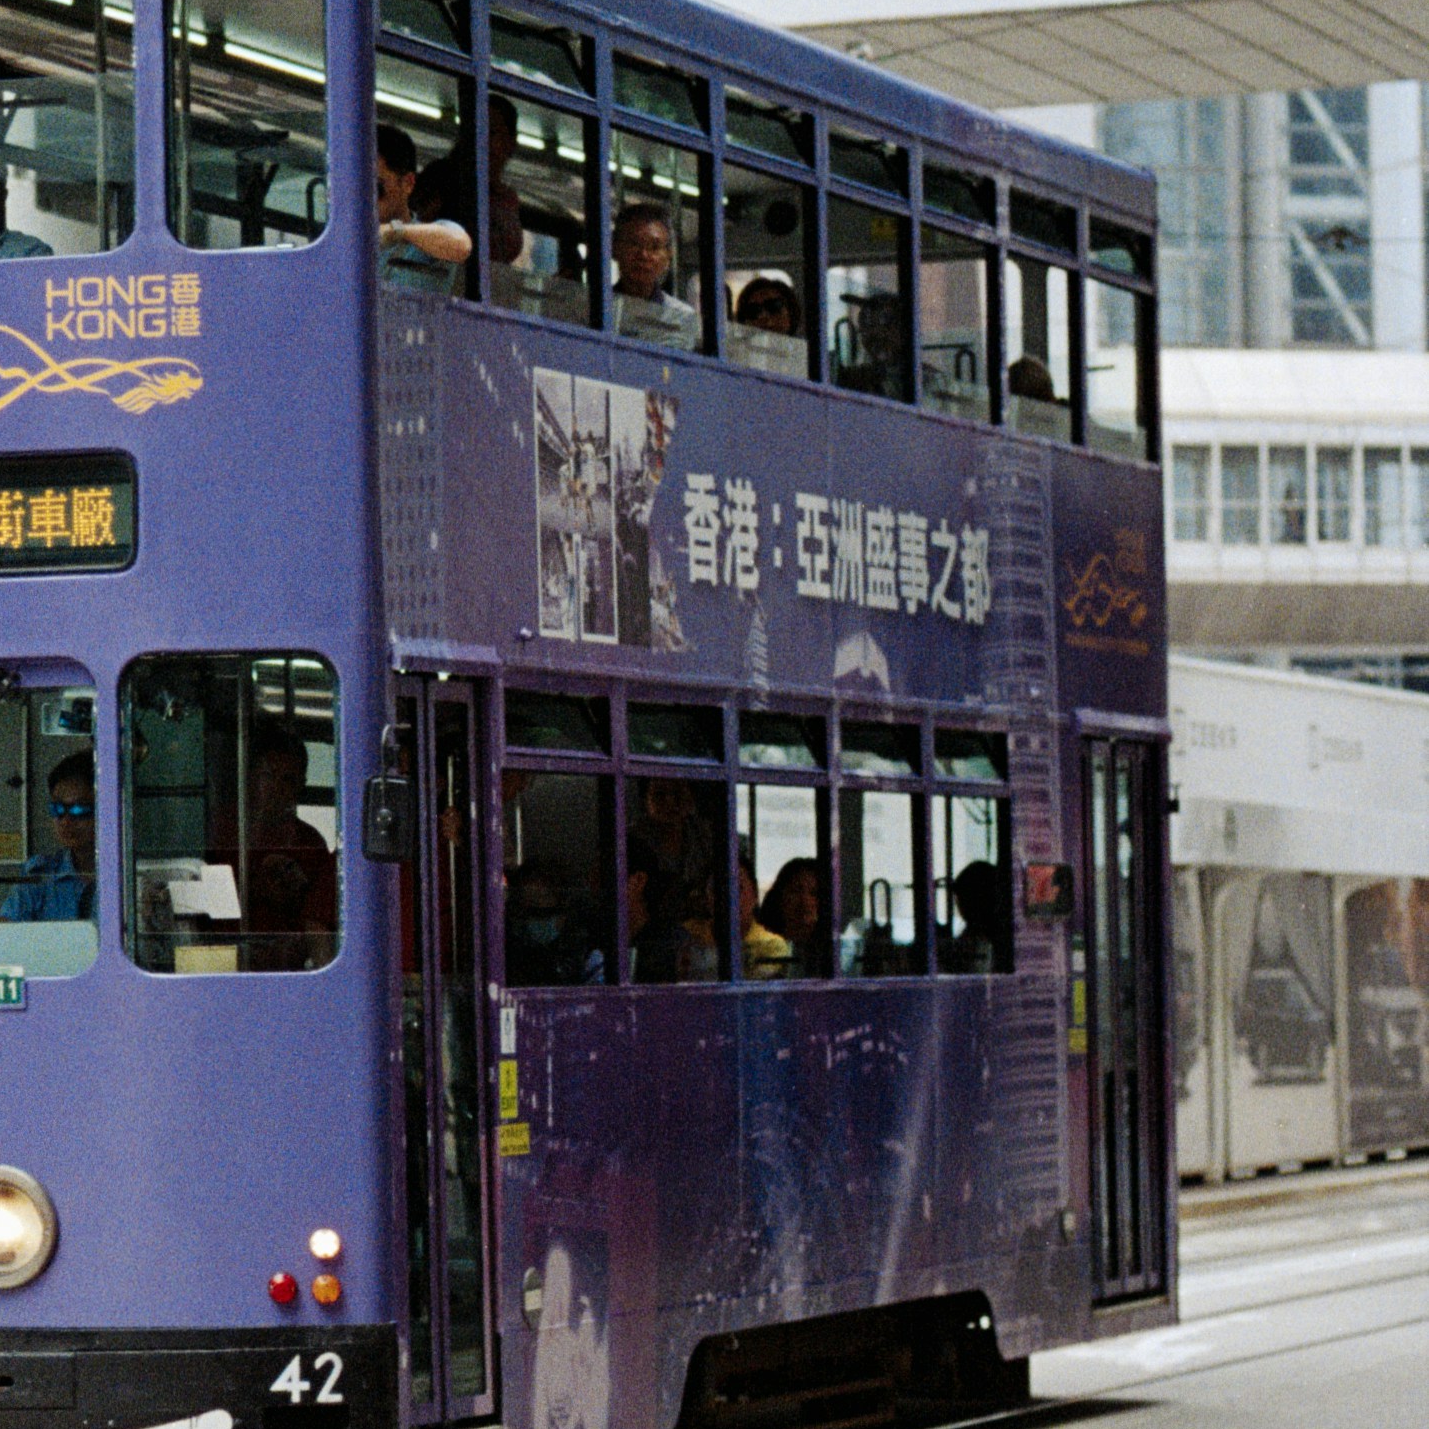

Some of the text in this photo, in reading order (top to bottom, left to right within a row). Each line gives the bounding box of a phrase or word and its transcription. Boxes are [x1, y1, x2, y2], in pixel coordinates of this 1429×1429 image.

[45, 274, 167, 308] HONG
[45, 307, 168, 341] KONG
[269, 1351, 345, 1405] 42
